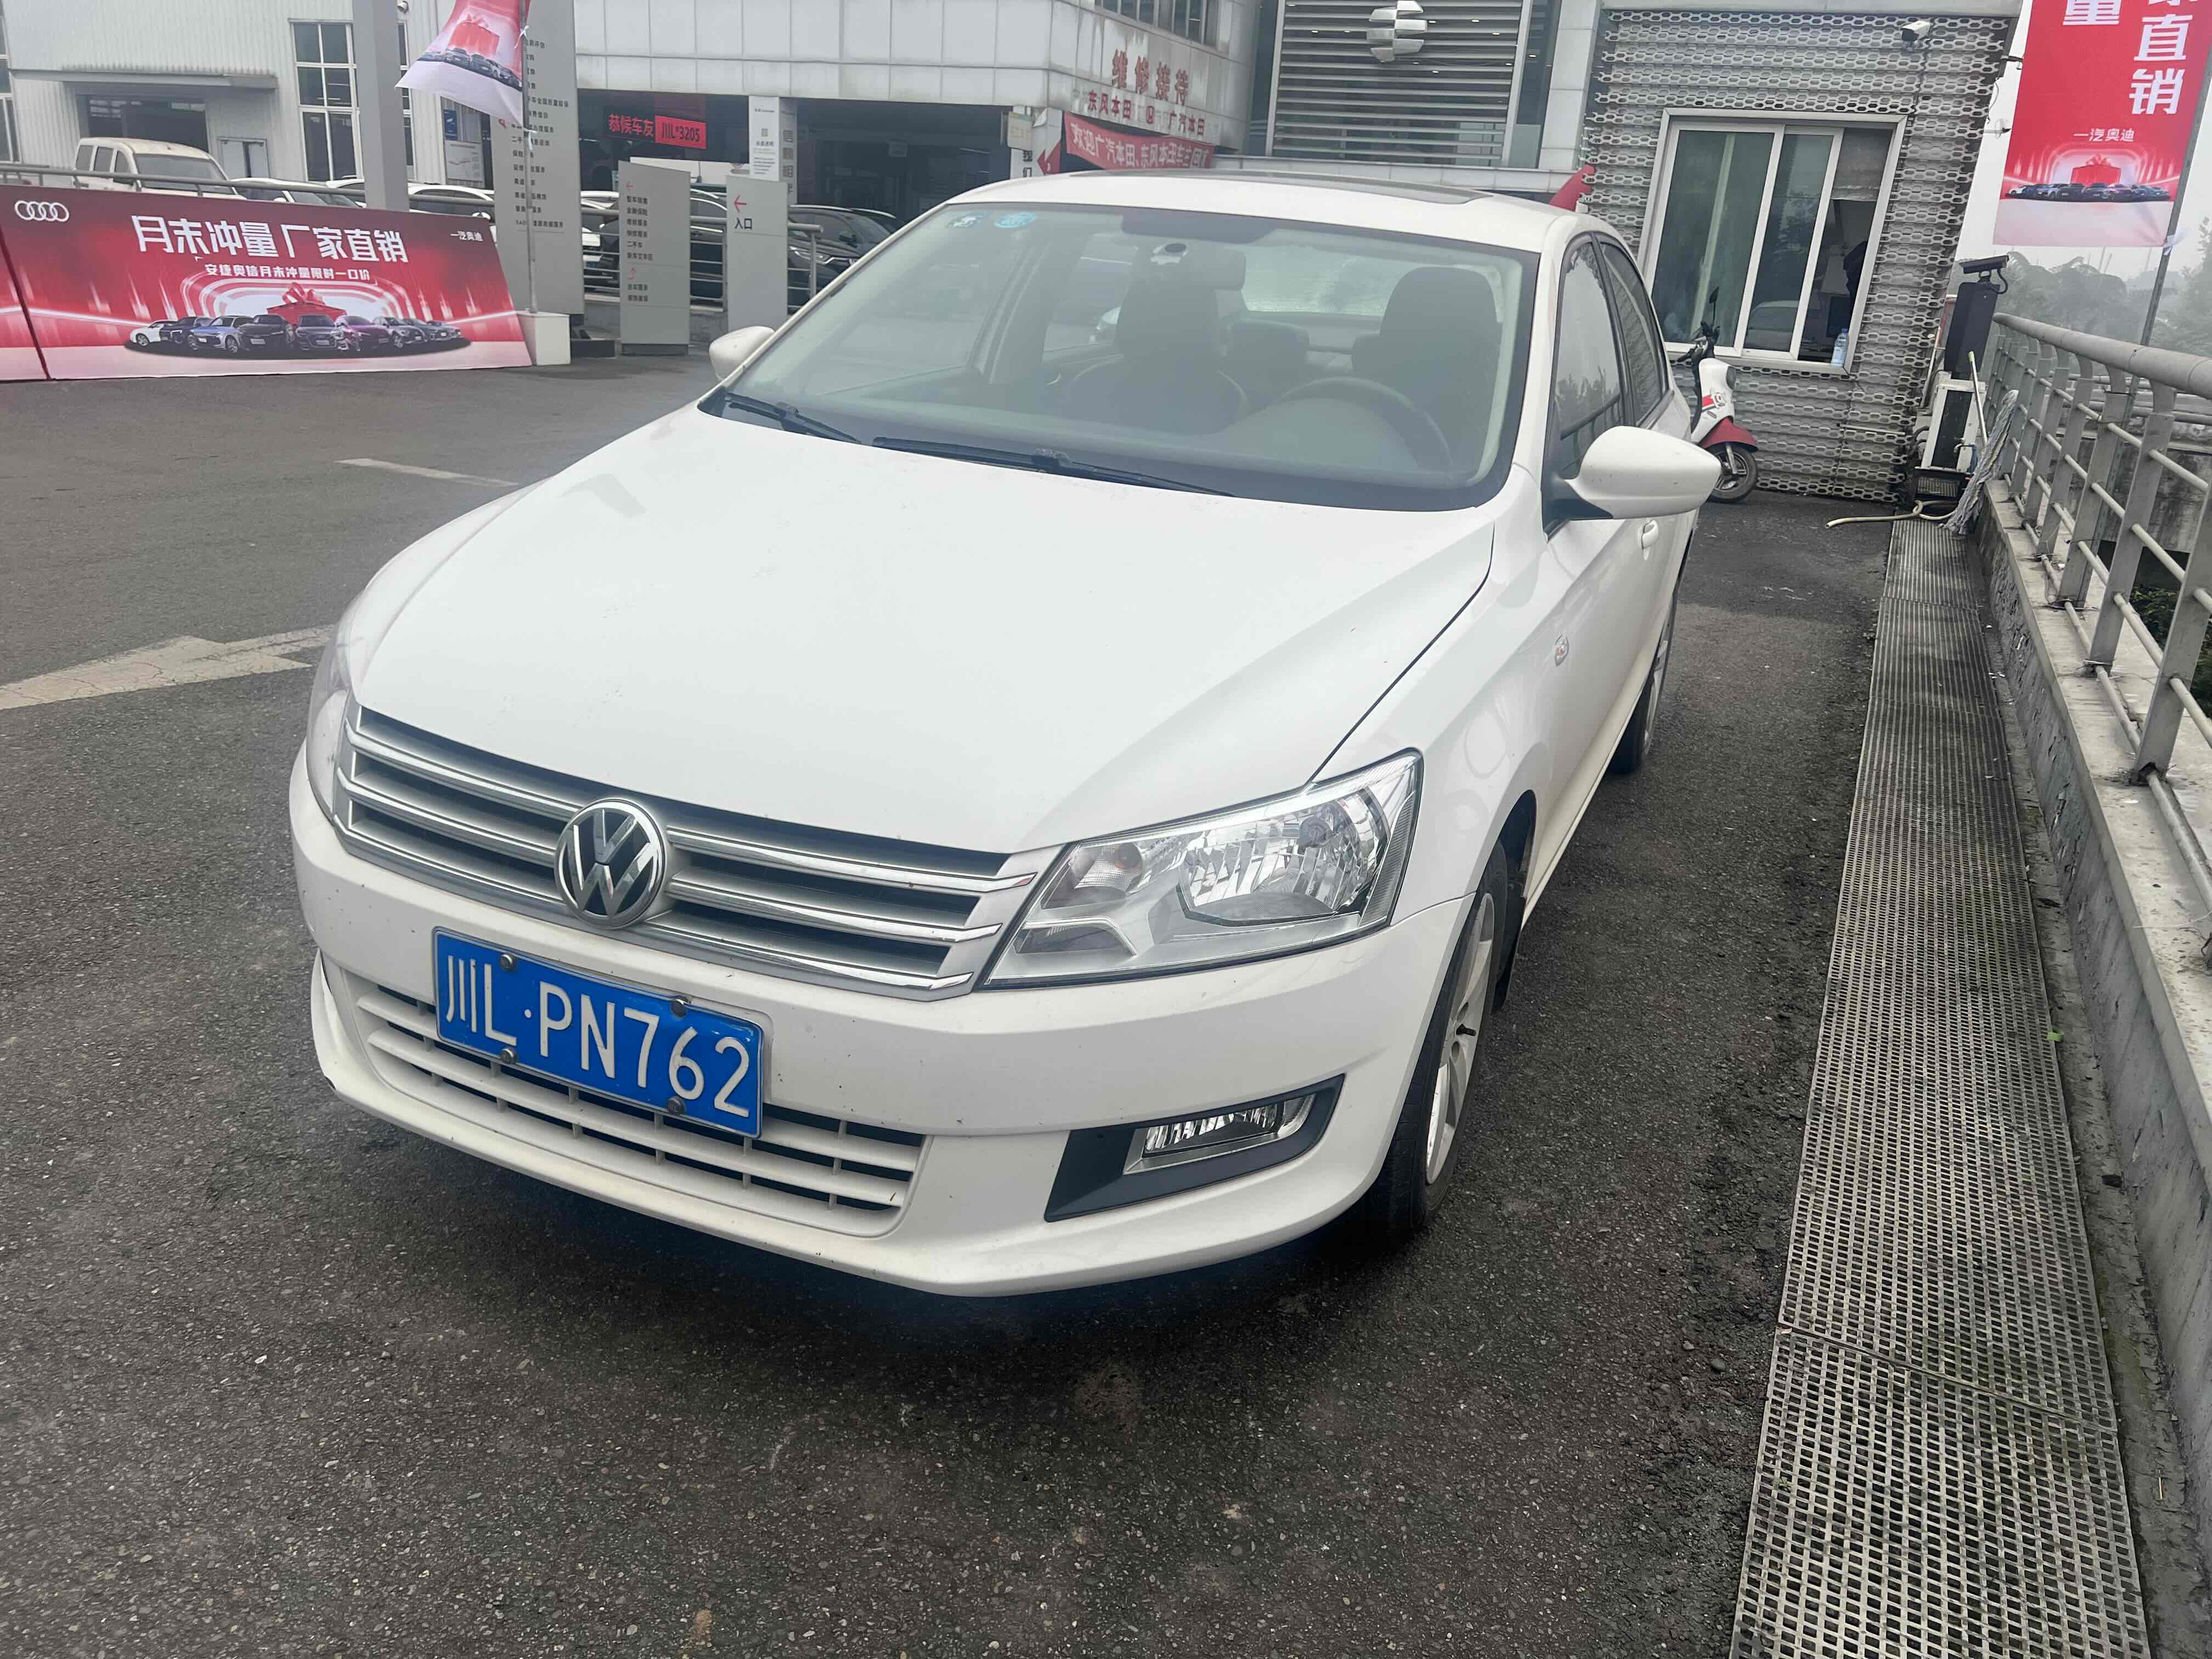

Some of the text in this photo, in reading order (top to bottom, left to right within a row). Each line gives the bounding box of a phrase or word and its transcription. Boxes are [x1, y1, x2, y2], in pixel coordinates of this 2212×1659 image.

[2129, 0, 2198, 115] 直销
[1111, 48, 1189, 106] 维修接待
[1088, 89, 1132, 120] 东风本田
[608, 113, 654, 137] 恭候车友
[1168, 110, 1205, 137] 广汽本田
[2073, 128, 2134, 143] 一汽奥迪
[450, 230, 483, 242] 一汽奥迪
[734, 218, 753, 230] 入口
[132, 216, 409, 263] 月末冲量 厂家直销
[204, 264, 370, 282] 安捷奥信月末冲量限时一口价
[446, 955, 750, 1119] 川L·PN762
